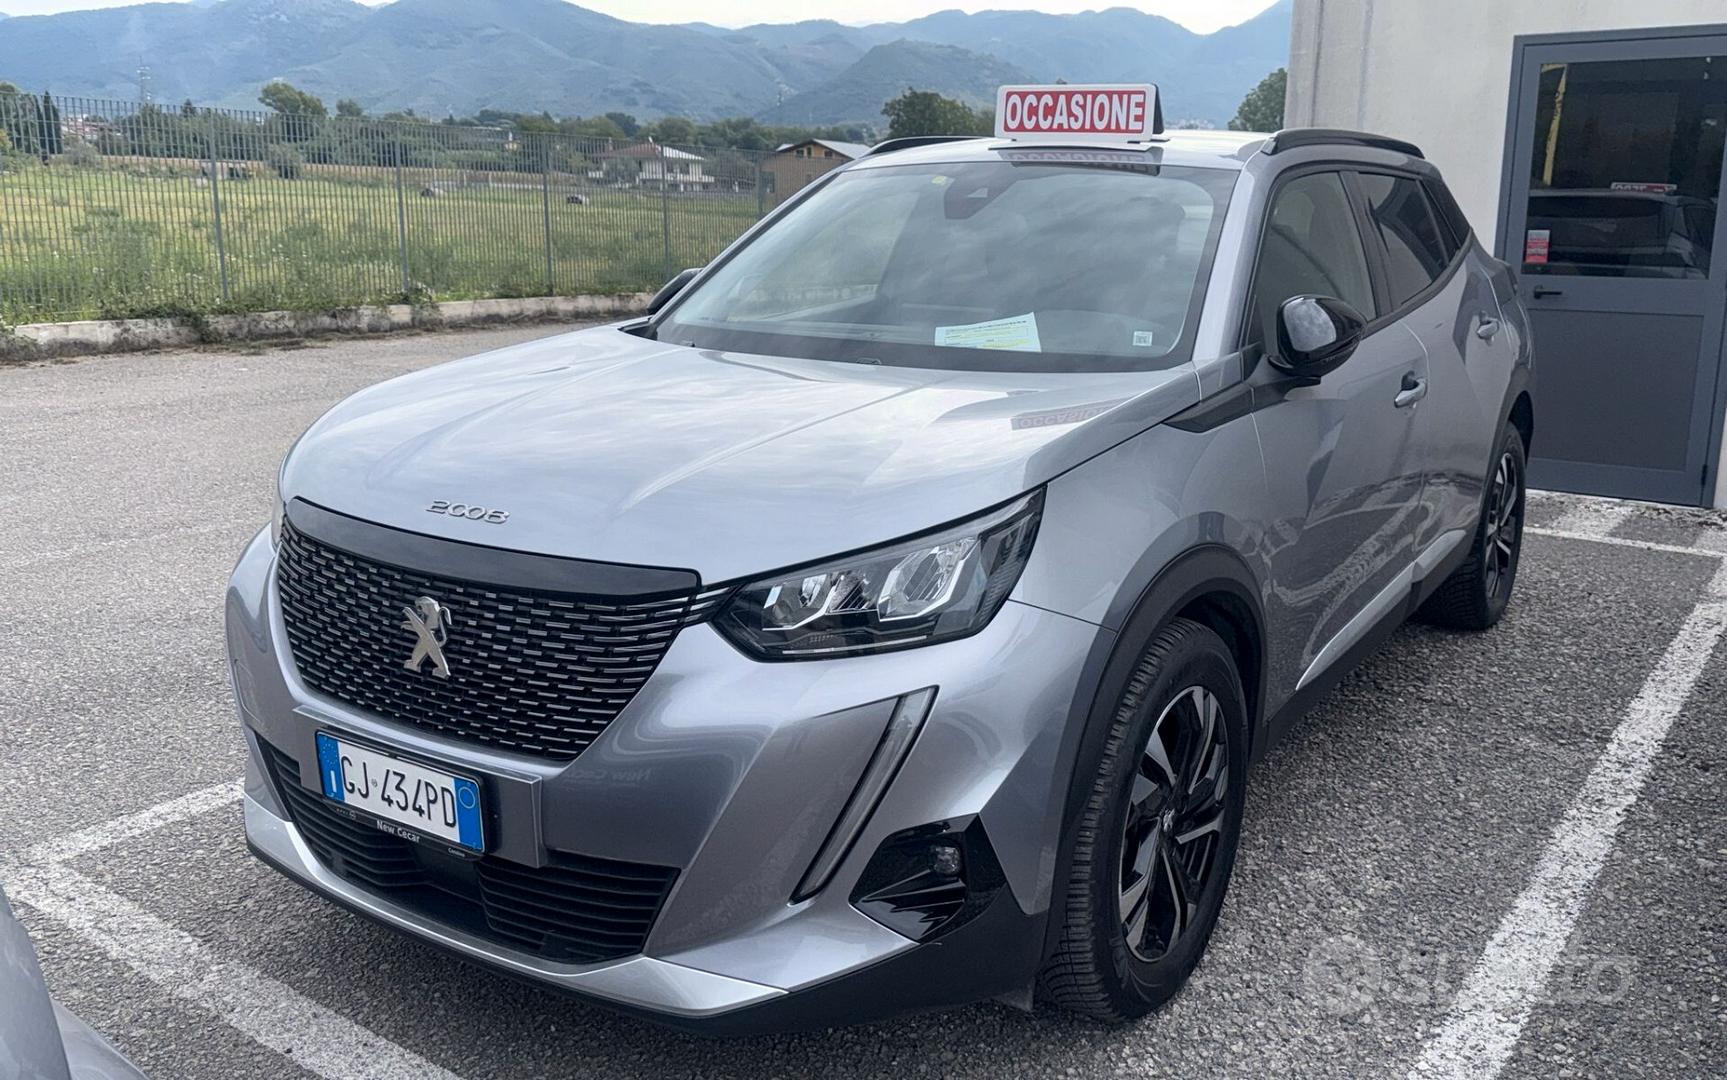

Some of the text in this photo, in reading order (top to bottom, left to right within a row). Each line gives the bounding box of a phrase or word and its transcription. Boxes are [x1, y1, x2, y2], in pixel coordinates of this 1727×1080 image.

[1005, 93, 1145, 131] OCCASIONE
[424, 499, 510, 525] 2008
[340, 755, 370, 799] GJ
[380, 768, 457, 828] 434PD
[376, 820, 420, 844] New Cecar
